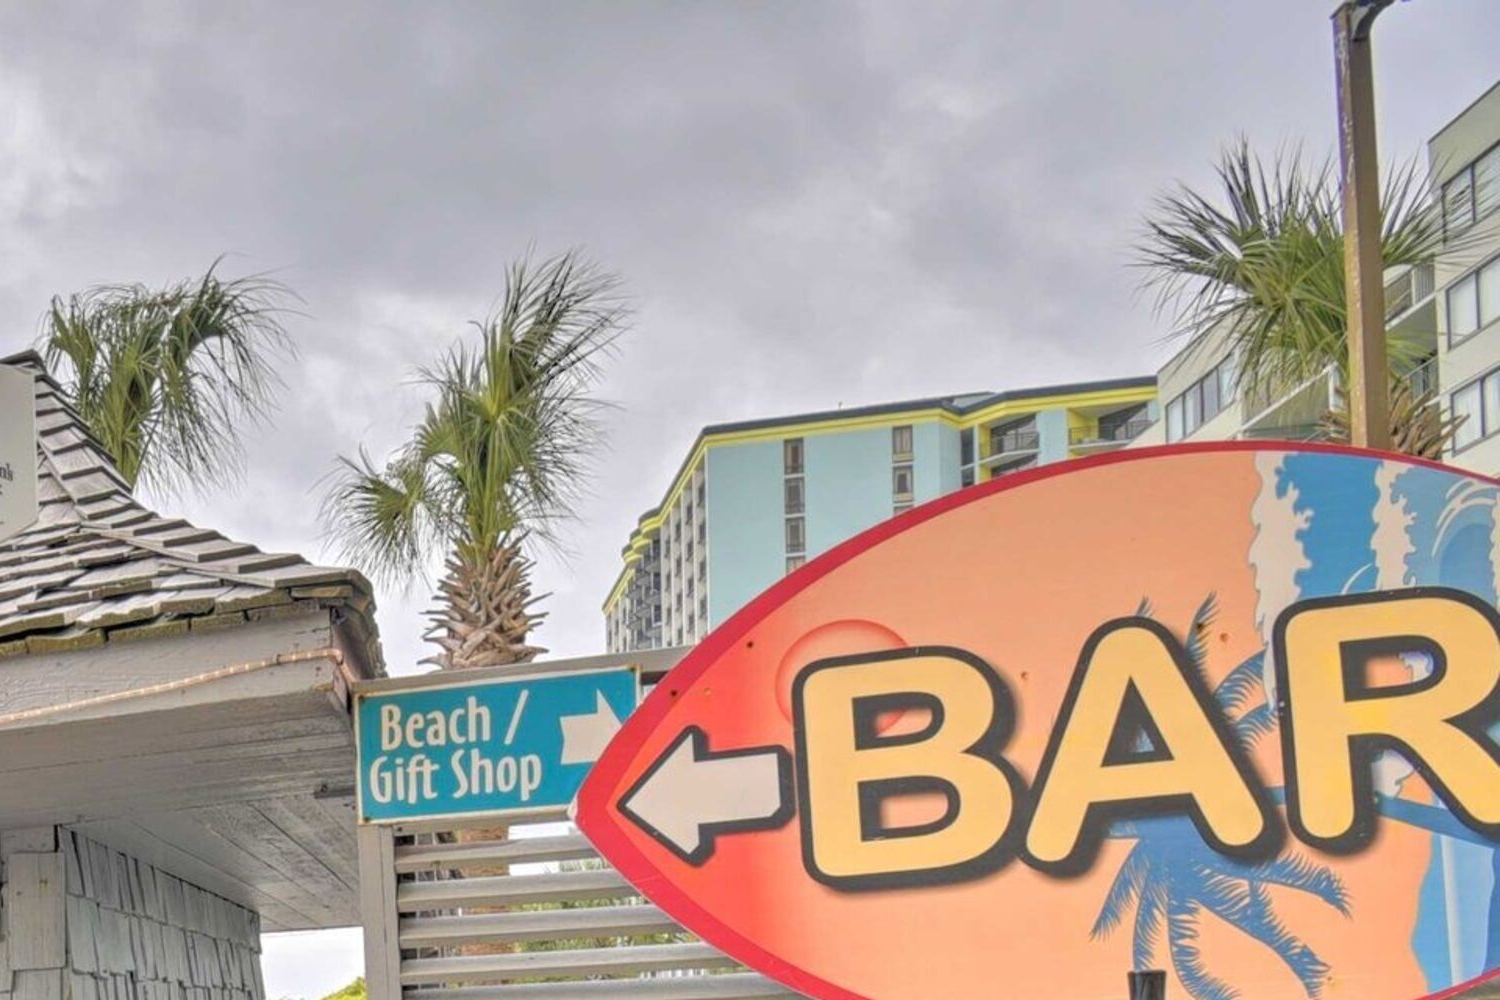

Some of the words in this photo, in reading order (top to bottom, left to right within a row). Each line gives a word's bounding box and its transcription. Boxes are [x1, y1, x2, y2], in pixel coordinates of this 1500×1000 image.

[381, 696, 491, 751] Beach
[503, 689, 529, 745] /
[794, 587, 1500, 892] BAR
[370, 753, 440, 804] Gift
[451, 748, 542, 801] Shop
